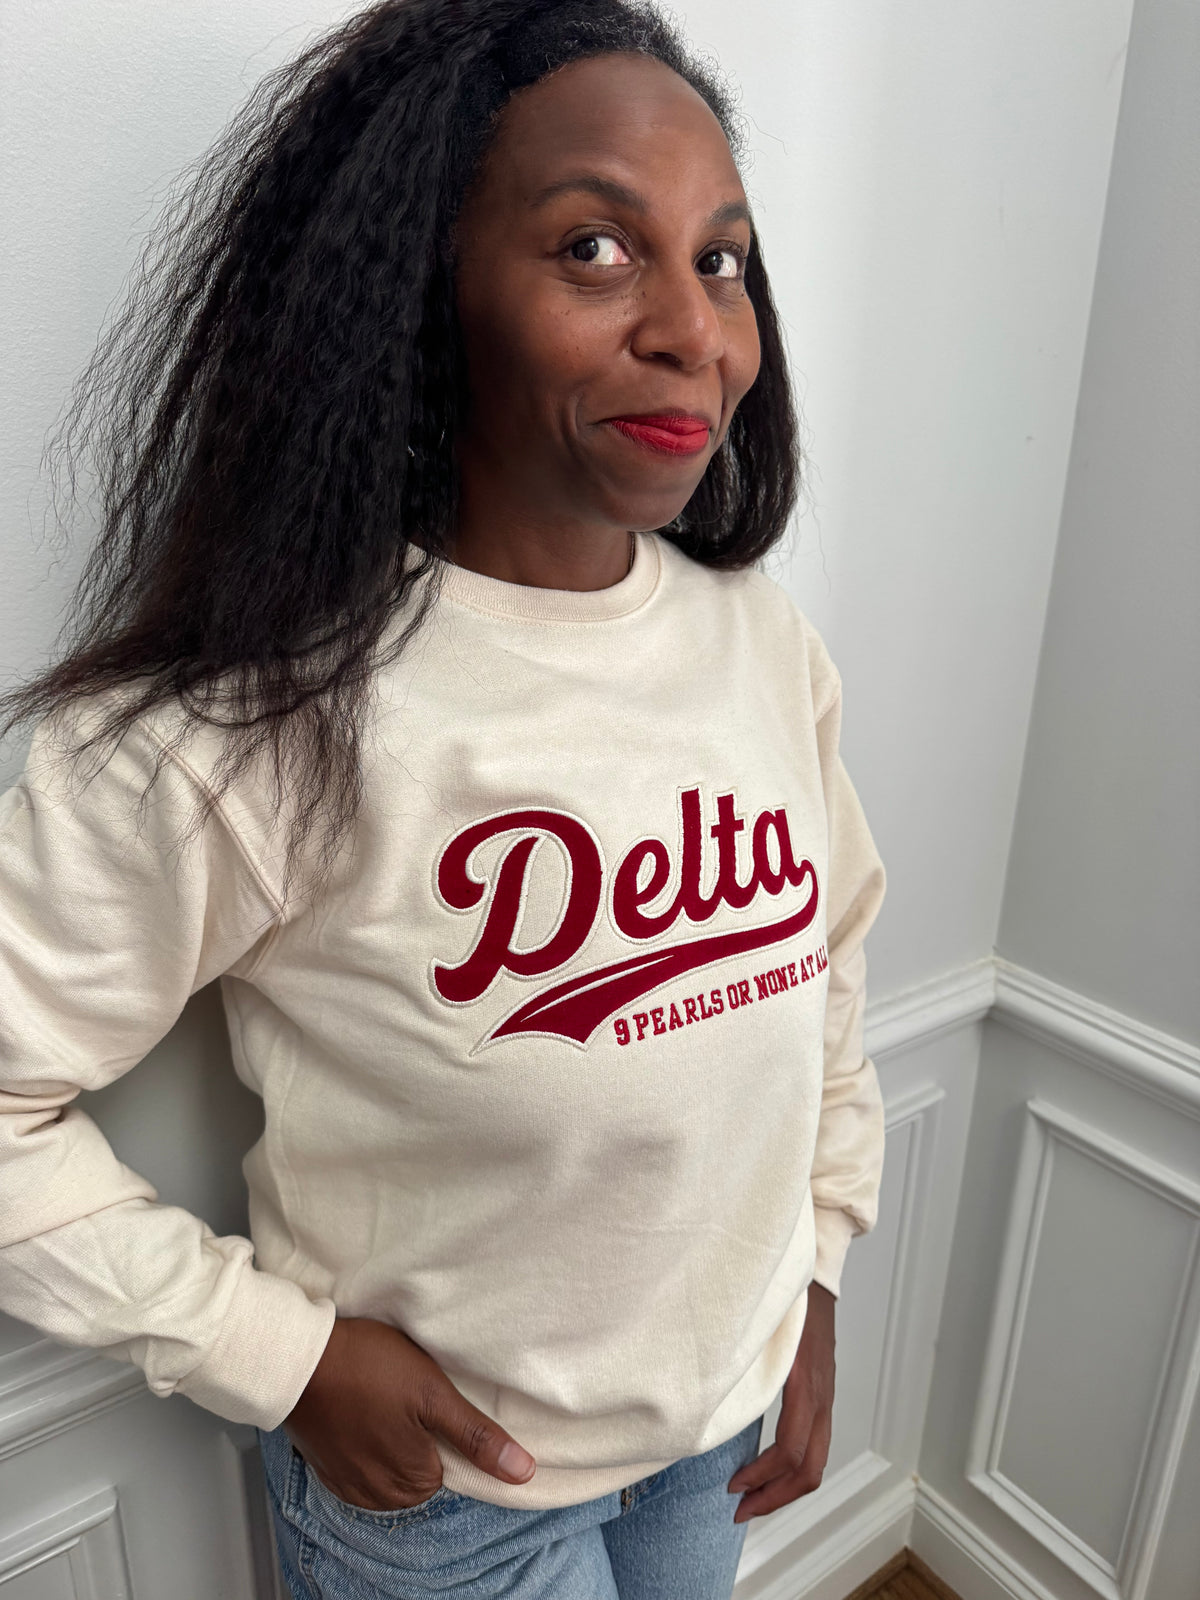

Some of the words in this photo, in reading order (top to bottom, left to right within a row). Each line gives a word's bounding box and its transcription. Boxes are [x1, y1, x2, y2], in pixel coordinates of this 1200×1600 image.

[433, 786, 819, 1003] Delta
[613, 1018, 631, 1047] 9
[632, 988, 725, 1042] PEARLS
[726, 979, 754, 1011] OR
[753, 962, 799, 1001] NONE
[800, 954, 816, 983] AT
